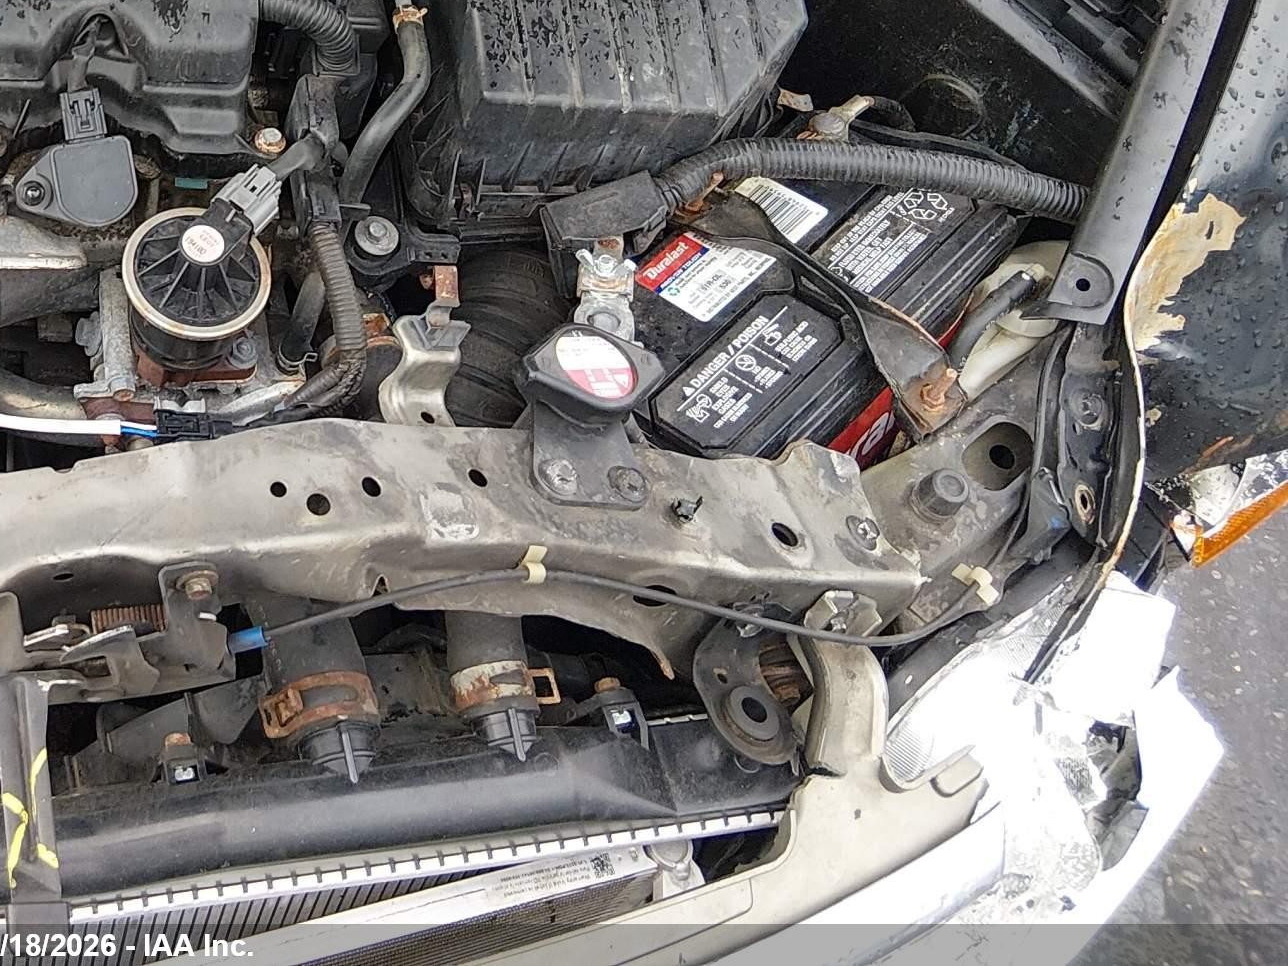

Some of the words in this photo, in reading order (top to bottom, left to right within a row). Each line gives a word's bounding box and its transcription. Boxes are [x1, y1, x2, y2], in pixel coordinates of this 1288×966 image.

[642, 240, 689, 281] Duralast
[689, 352, 730, 388] DANGER
[732, 314, 769, 348] POISON
